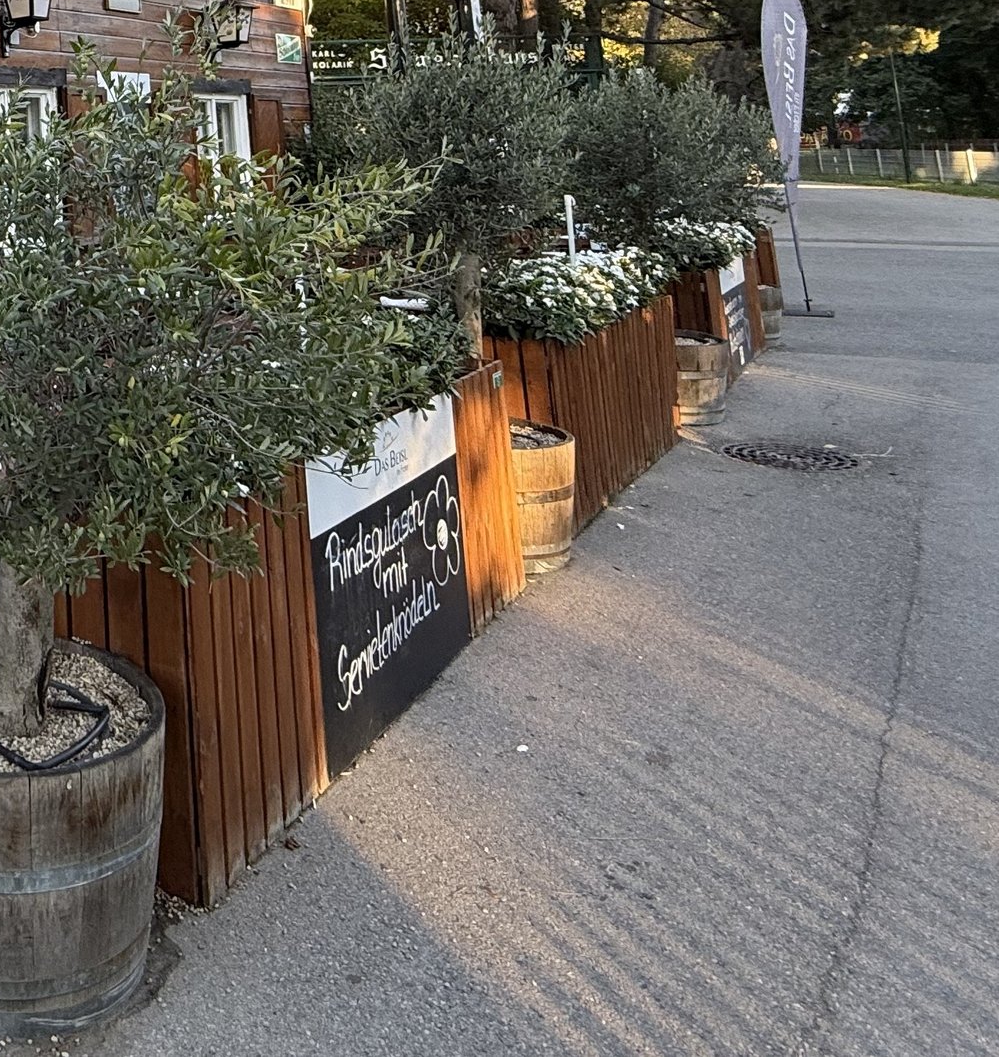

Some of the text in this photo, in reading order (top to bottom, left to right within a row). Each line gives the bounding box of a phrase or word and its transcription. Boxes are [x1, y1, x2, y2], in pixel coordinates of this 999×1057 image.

[311, 50, 336, 58] KARL
[374, 458, 389, 476] DAS
[324, 489, 423, 591] Rindsgulasch
[381, 546, 408, 598] mit
